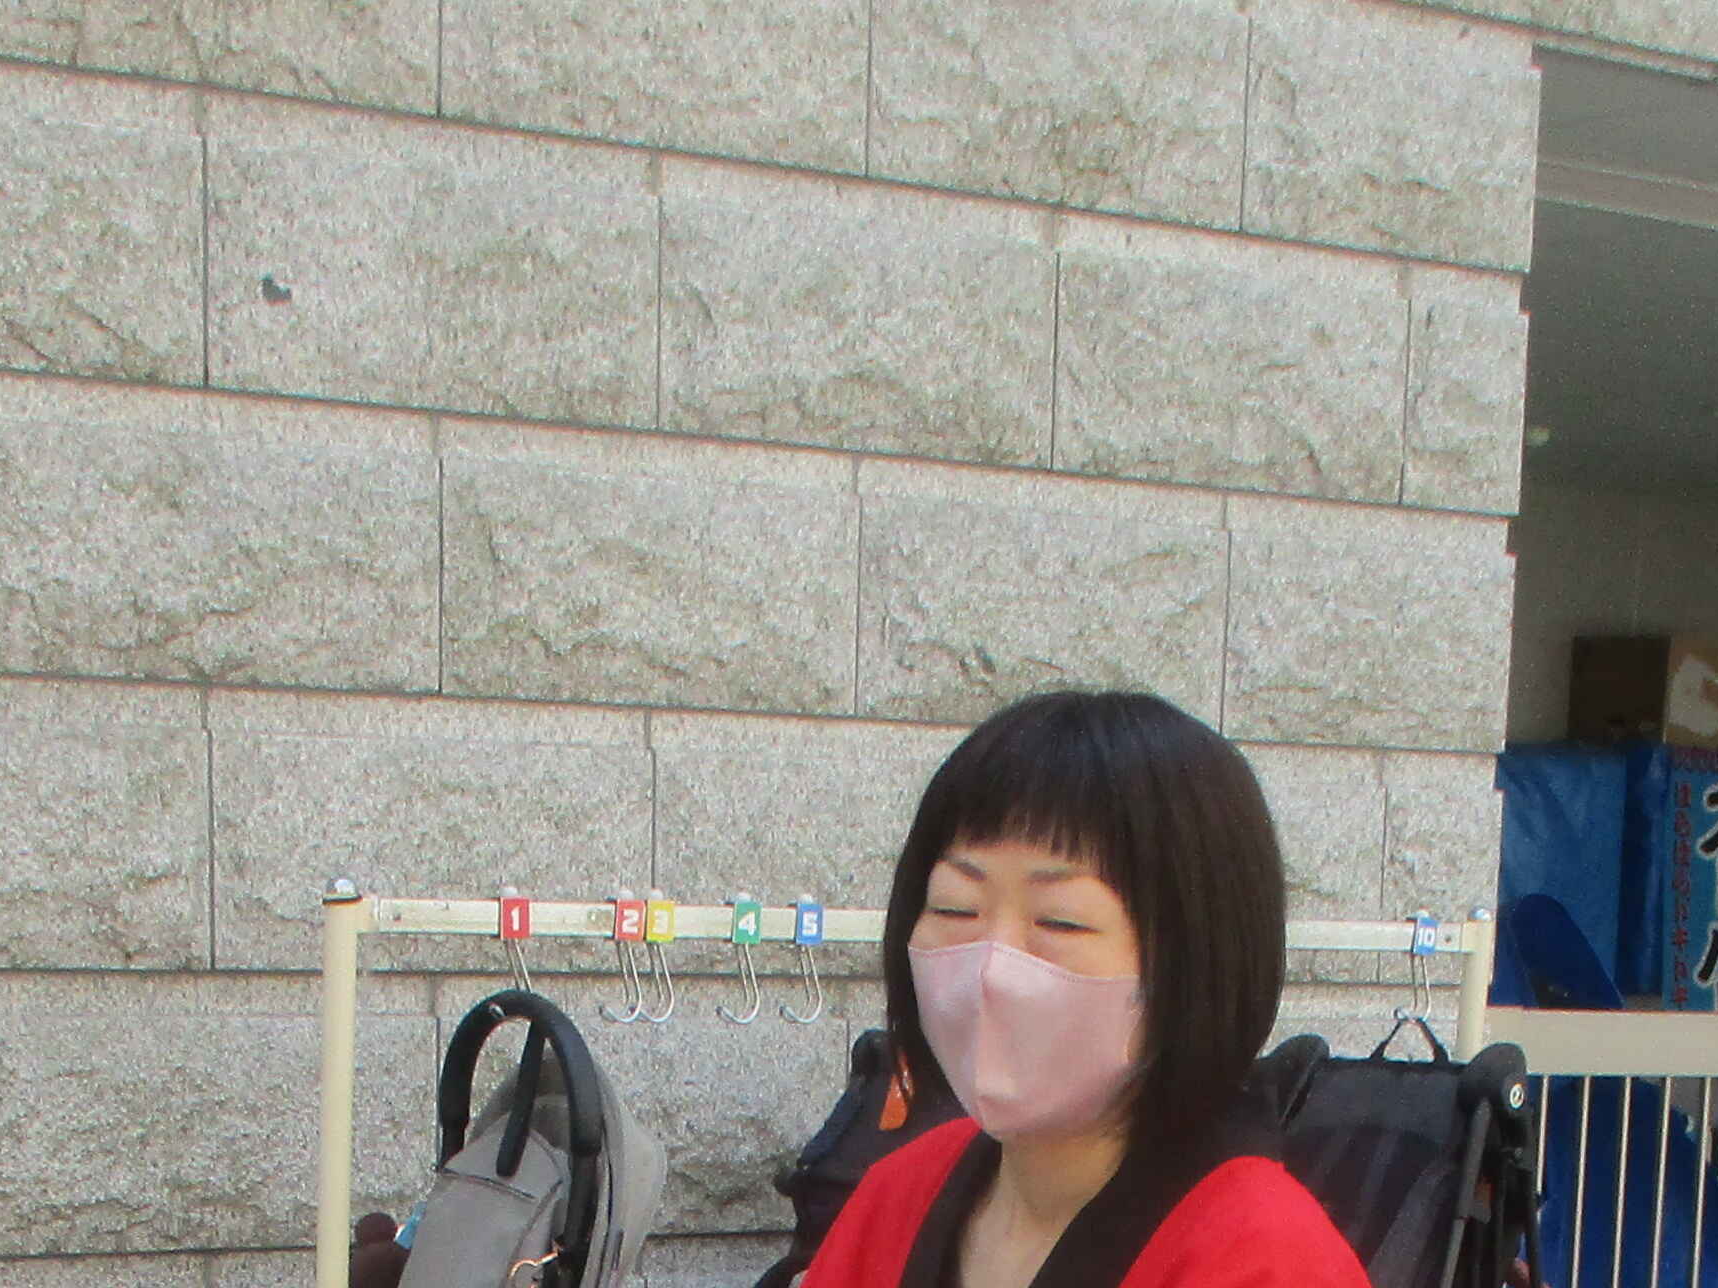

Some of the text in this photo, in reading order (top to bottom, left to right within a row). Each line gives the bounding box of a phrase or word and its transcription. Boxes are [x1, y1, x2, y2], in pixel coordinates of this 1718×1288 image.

[510, 906, 521, 931] 1
[621, 909, 640, 934] 2
[652, 909, 669, 934] 3
[738, 911, 757, 935] 4
[802, 911, 818, 935] 5
[1416, 926, 1435, 946] 10
